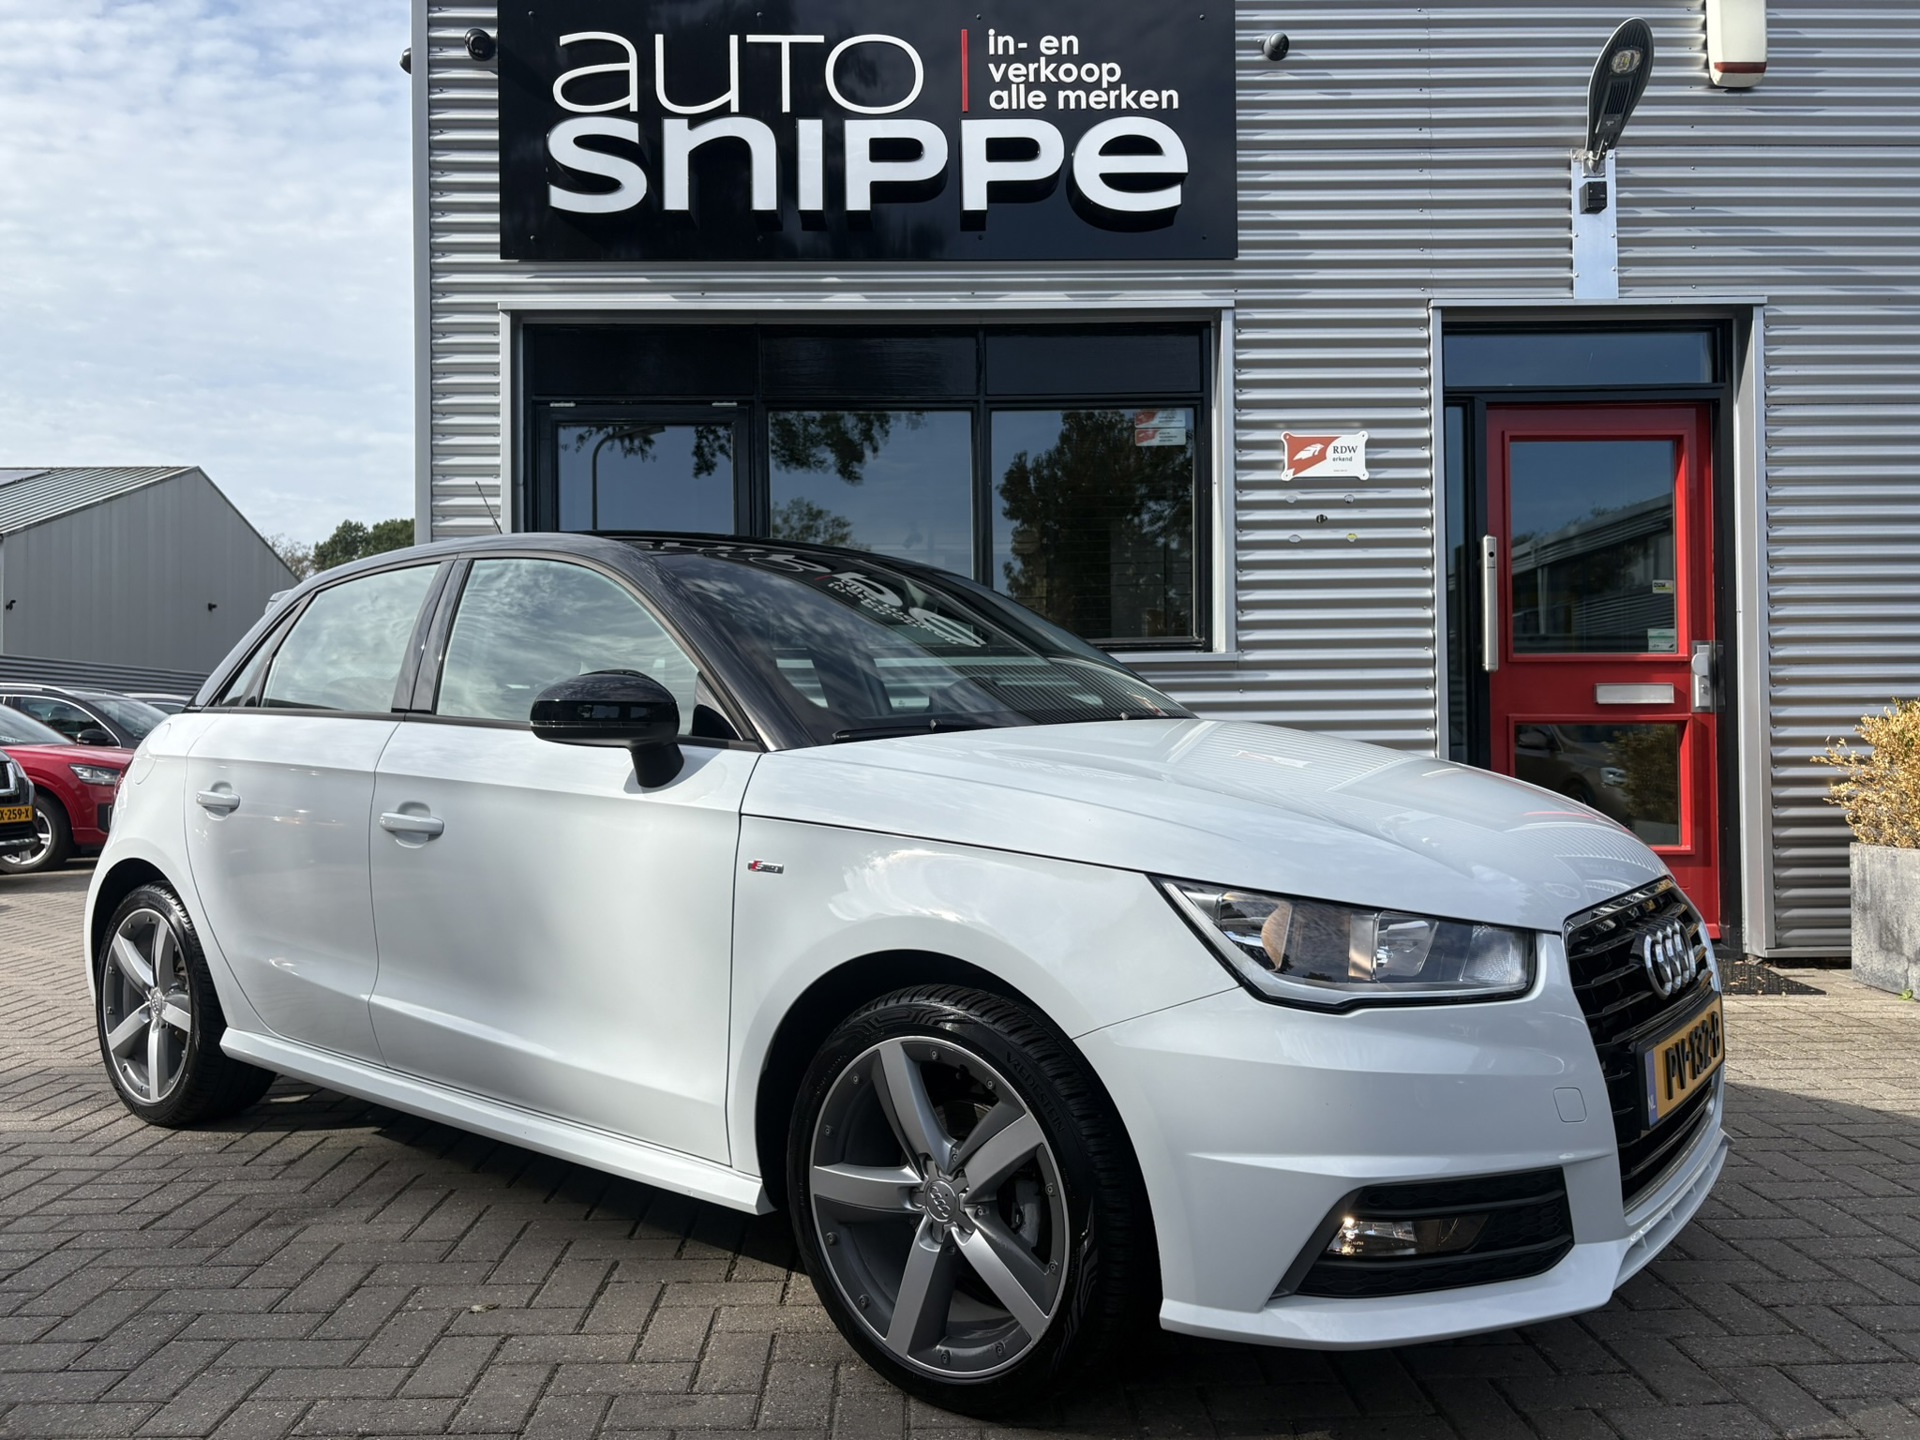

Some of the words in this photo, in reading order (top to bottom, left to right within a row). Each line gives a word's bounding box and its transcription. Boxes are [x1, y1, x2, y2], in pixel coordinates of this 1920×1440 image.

[987, 28, 1027, 56] in-
[1039, 34, 1079, 56] en
[987, 59, 1122, 85] verkoop
[987, 85, 1046, 110] alle
[1057, 85, 1179, 110] merken
[1333, 445, 1358, 454] RDW
[1664, 1011, 1720, 1101] PV-132-B
